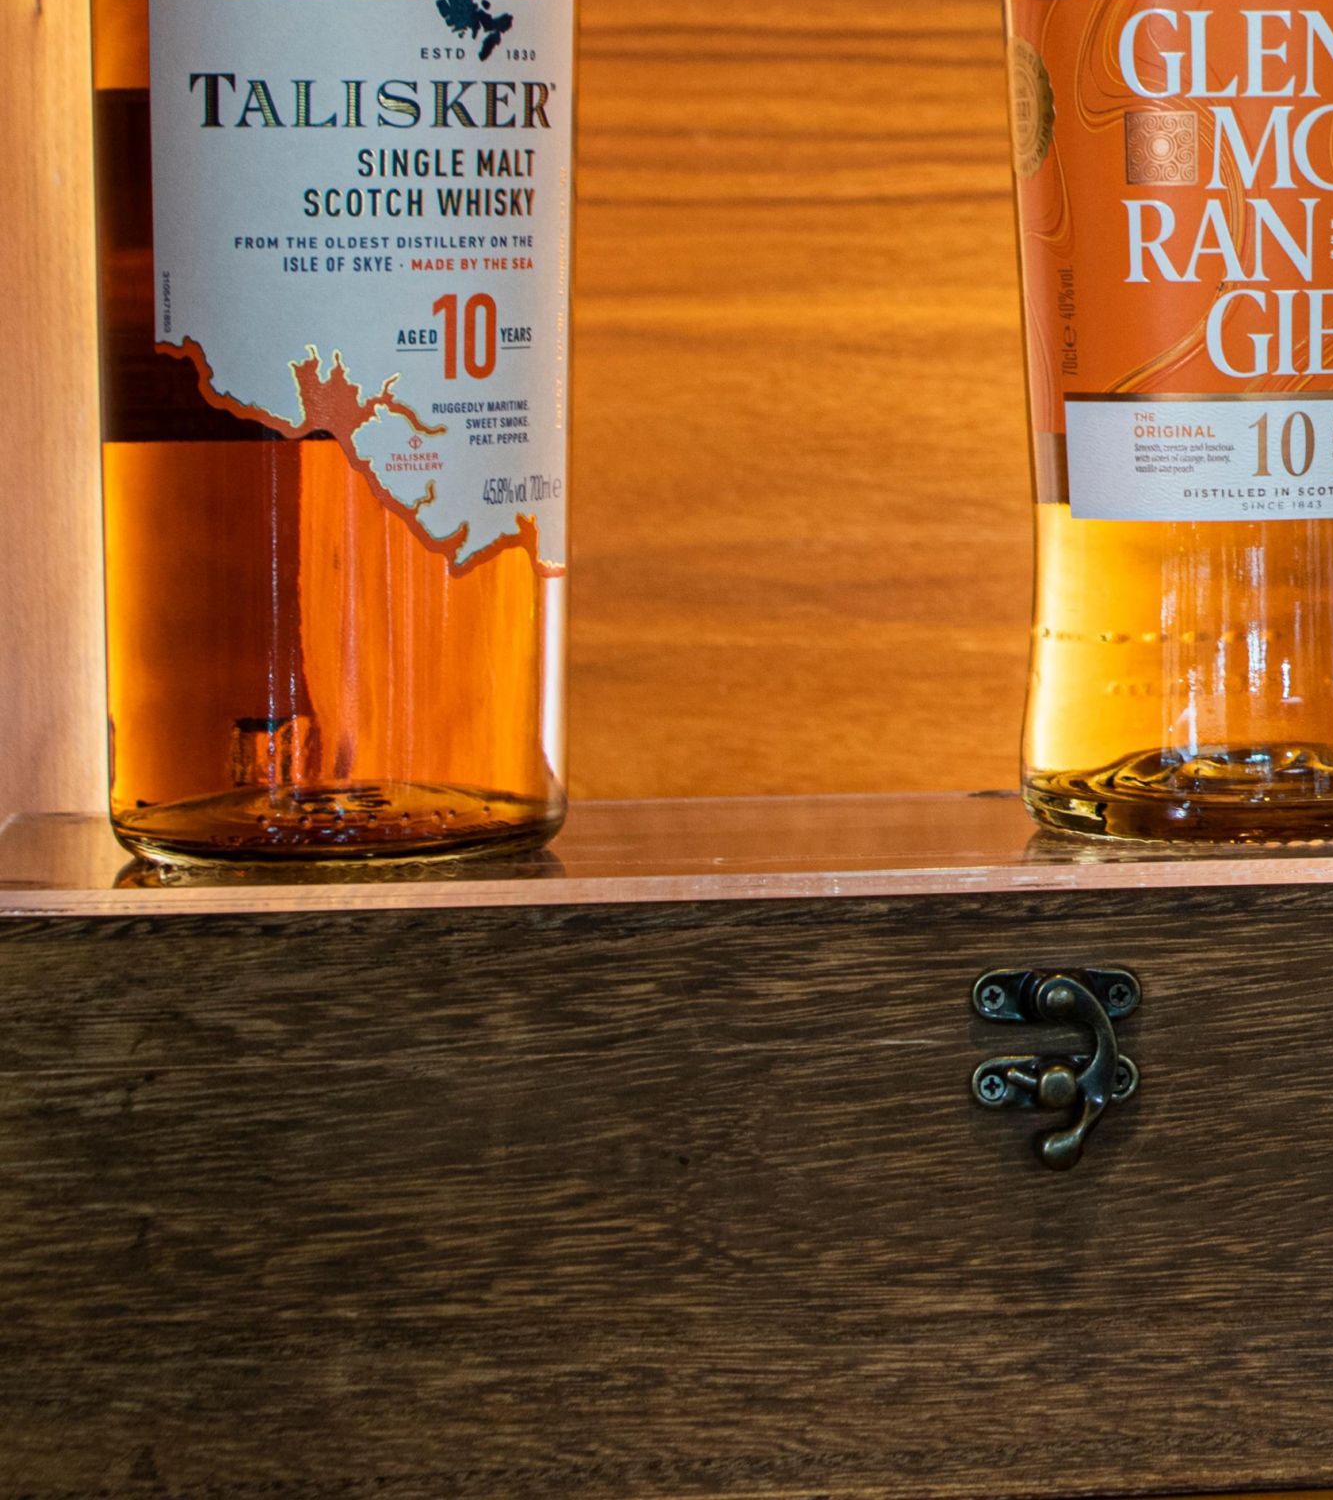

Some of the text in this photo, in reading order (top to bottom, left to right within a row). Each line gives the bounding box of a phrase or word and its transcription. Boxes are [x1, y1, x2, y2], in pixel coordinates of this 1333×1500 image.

[420, 47, 537, 61] ESTD 1830
[189, 72, 554, 129] TALISKER
[357, 149, 536, 178] SINGLE MALT
[303, 188, 536, 217] SCOTCH WHISKY
[234, 235, 534, 250] FROM THE OLDEST DISTILLERY ON THE
[1121, 198, 1321, 283] RAN
[283, 256, 534, 272] ISLE OF SKYE MADE BY THE SEA
[396, 293, 532, 380] AGED 10 YEARS
[432, 400, 530, 414] RUGGEDLY MARITIME.
[466, 416, 530, 429] SWEET SMOKE.
[1134, 412, 1156, 422] THE
[1134, 425, 1216, 438] ORIGINAL
[469, 433, 530, 446] PEAT. PEPPER.
[1248, 410, 1316, 478] 10
[391, 453, 439, 462] TALISKER
[385, 463, 444, 472] DISTILLERY
[1184, 488, 1266, 498] DISTILLED
[1275, 487, 1290, 497] IN
[1242, 500, 1323, 511] SINCE 1843
